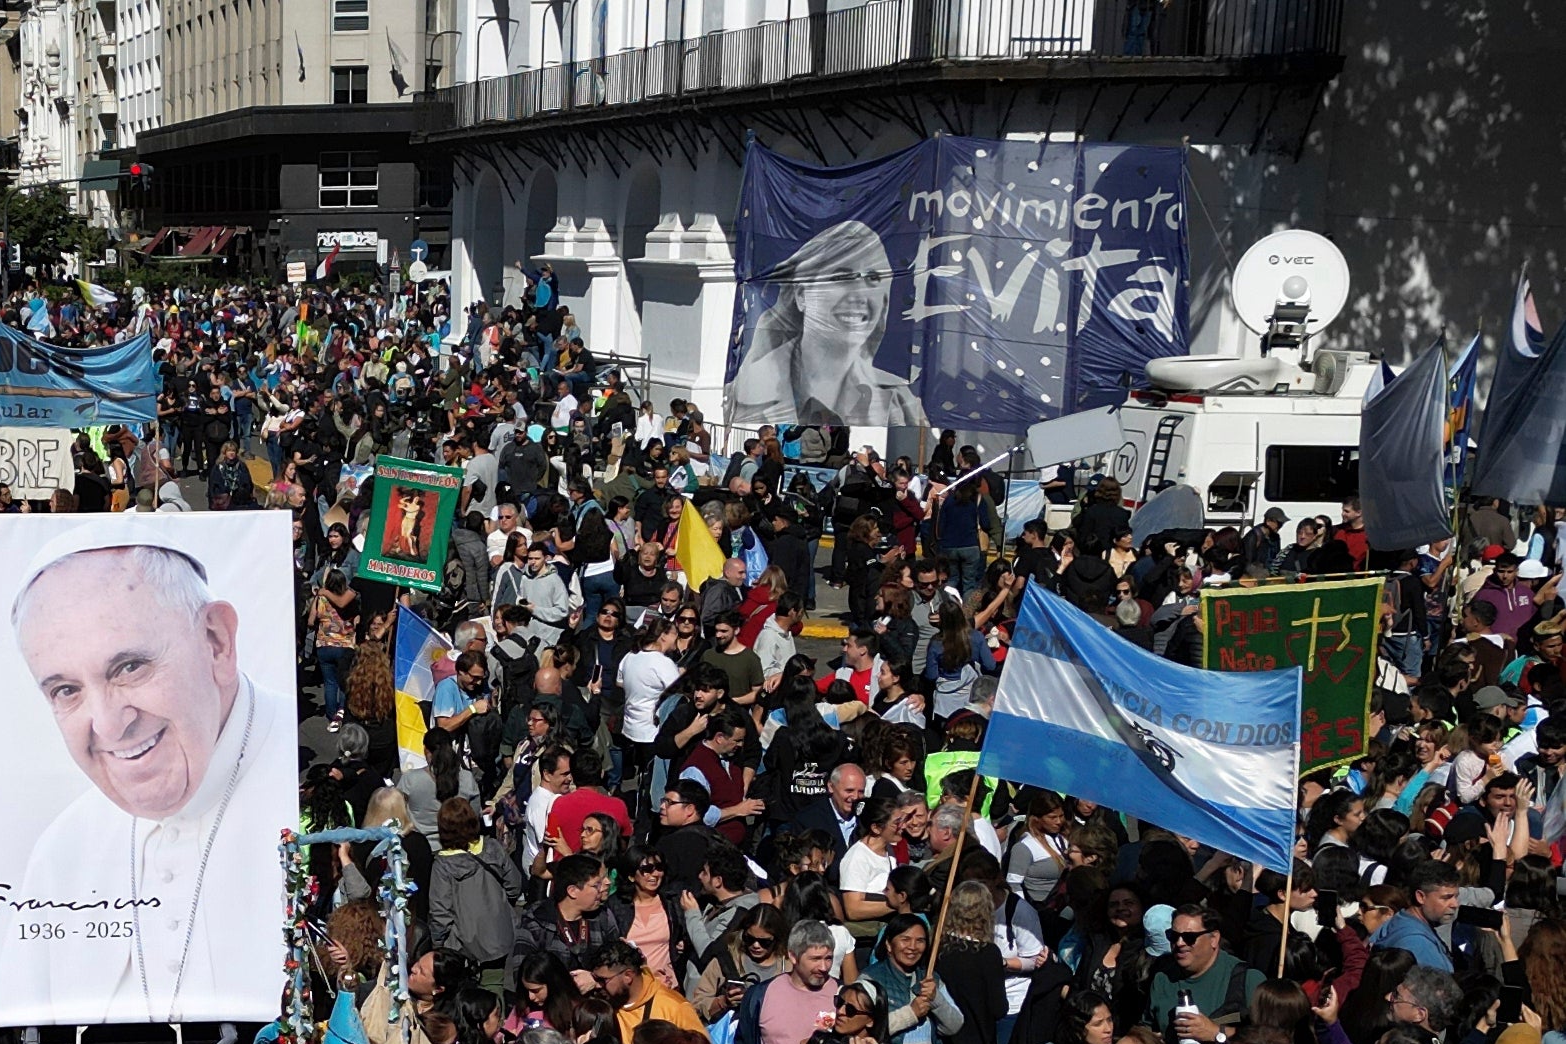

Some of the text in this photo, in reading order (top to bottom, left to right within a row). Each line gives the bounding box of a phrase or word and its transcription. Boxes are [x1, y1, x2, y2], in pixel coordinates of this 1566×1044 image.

[908, 187, 1184, 230] movimiento
[901, 234, 1182, 343] Evita
[1117, 454, 1134, 474] TV
[1171, 712, 1235, 743] CON
[19, 922, 66, 940] 1936
[85, 921, 134, 939] 2025
